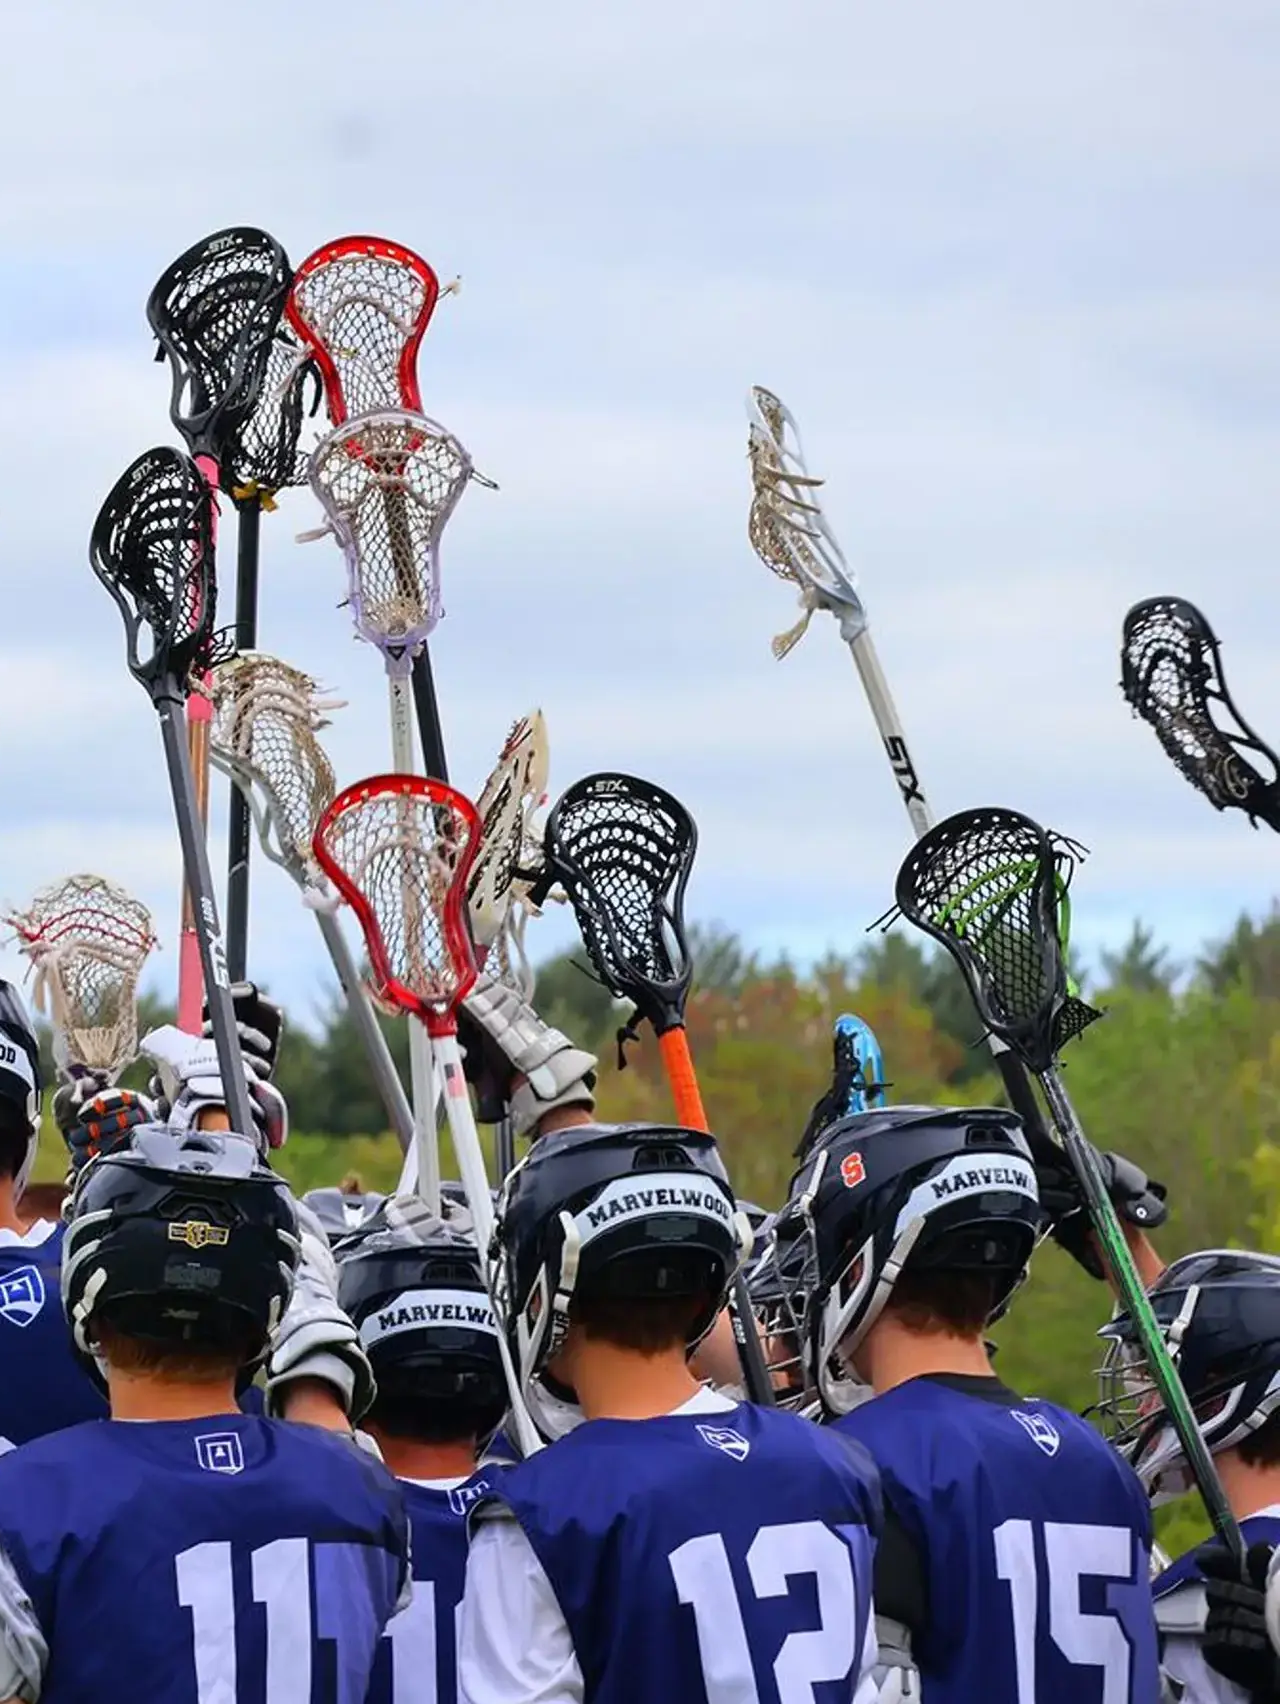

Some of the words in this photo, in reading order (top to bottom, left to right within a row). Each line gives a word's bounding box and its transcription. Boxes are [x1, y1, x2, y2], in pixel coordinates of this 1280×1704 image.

[208, 233, 235, 252] STX
[131, 457, 153, 483] STX
[595, 780, 623, 792] STX
[882, 735, 925, 806] STX
[205, 927, 228, 990] STX
[840, 1152, 866, 1188] S
[176, 1538, 311, 1704] 11
[668, 1520, 856, 1704] 12
[993, 1519, 1131, 1704] 15
